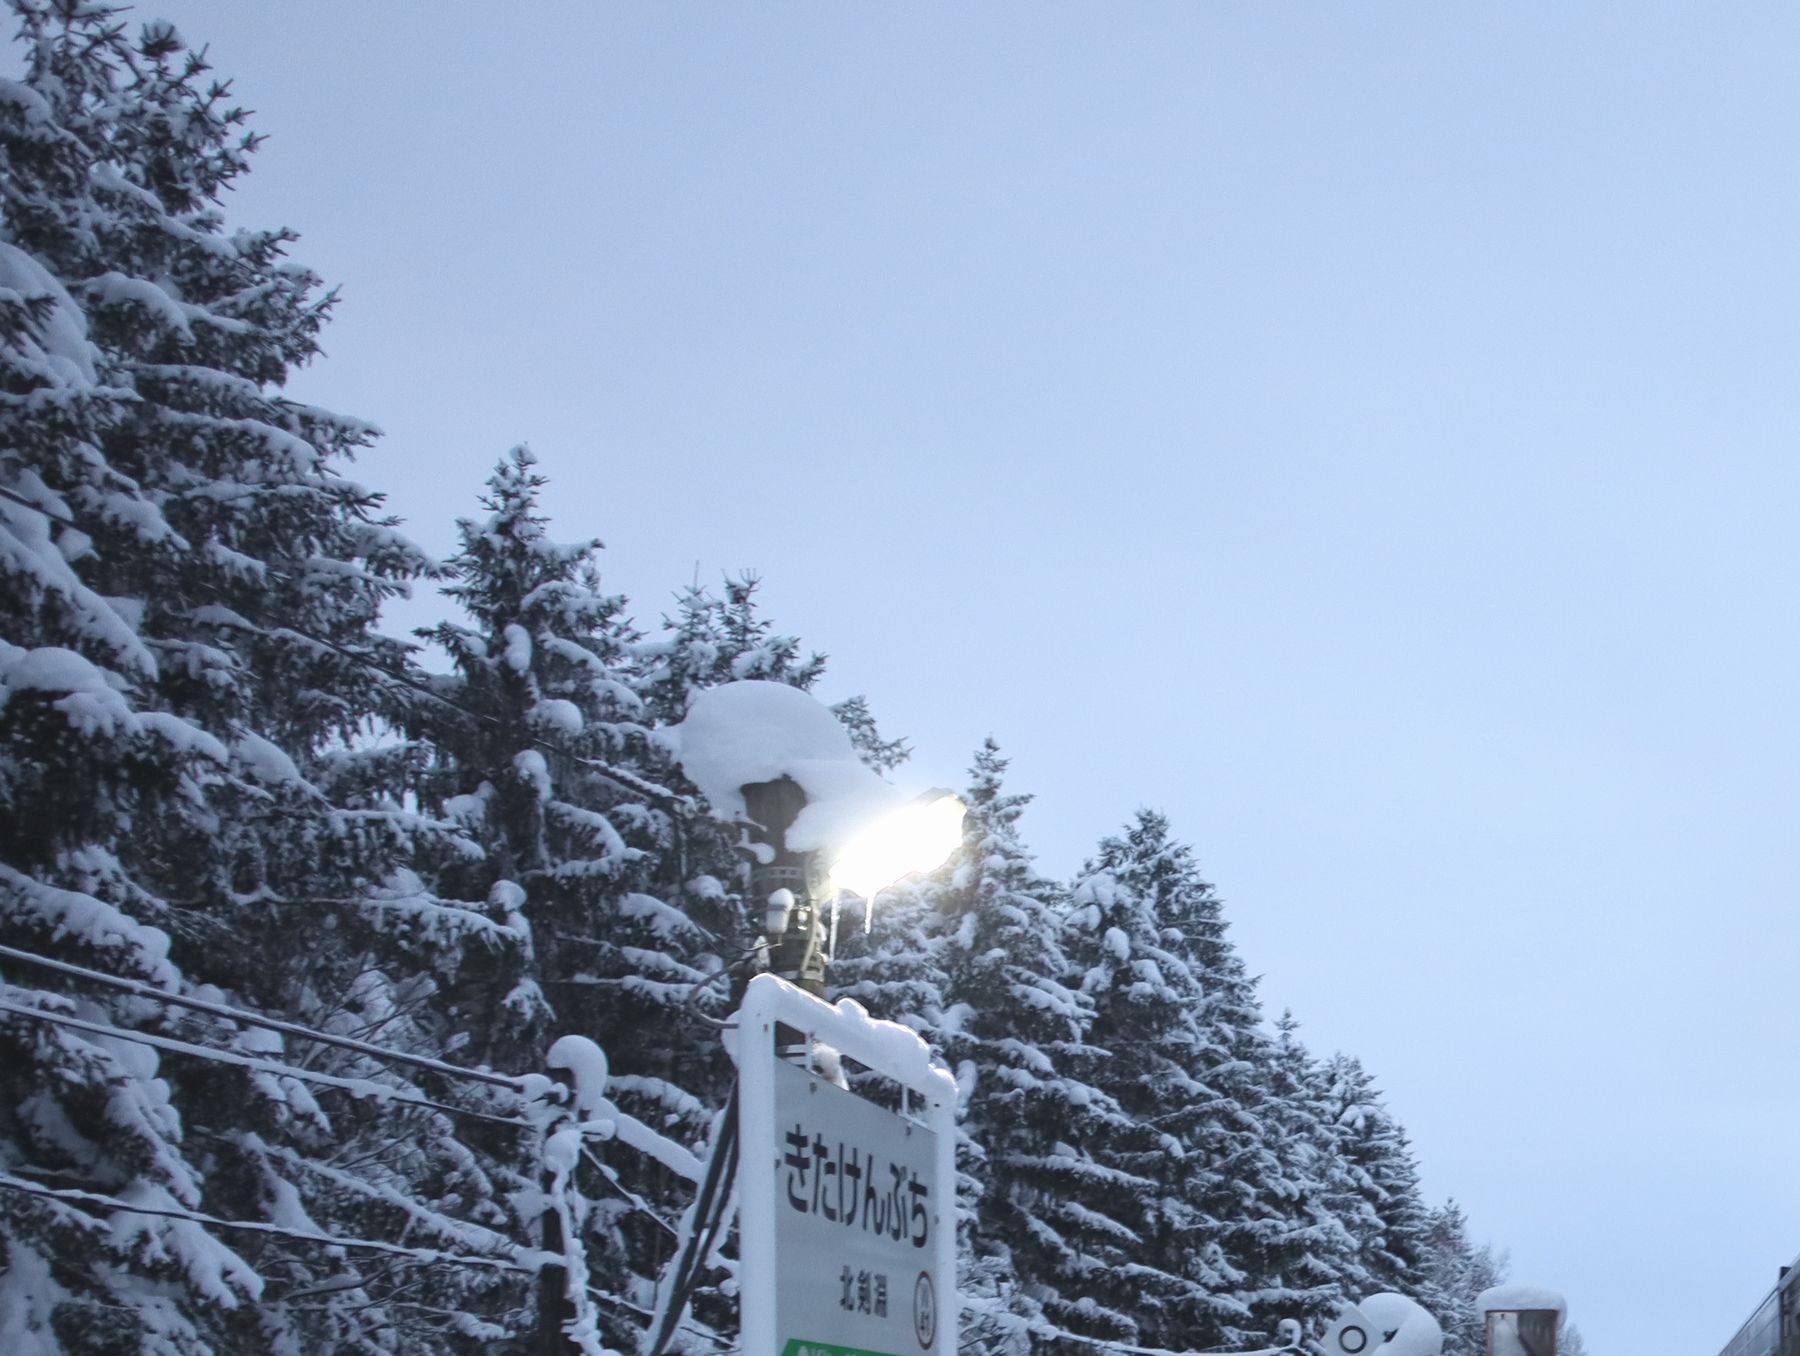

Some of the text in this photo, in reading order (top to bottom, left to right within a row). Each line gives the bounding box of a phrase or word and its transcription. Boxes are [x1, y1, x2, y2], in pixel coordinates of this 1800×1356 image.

[785, 1124, 928, 1248] きたけんぶち
